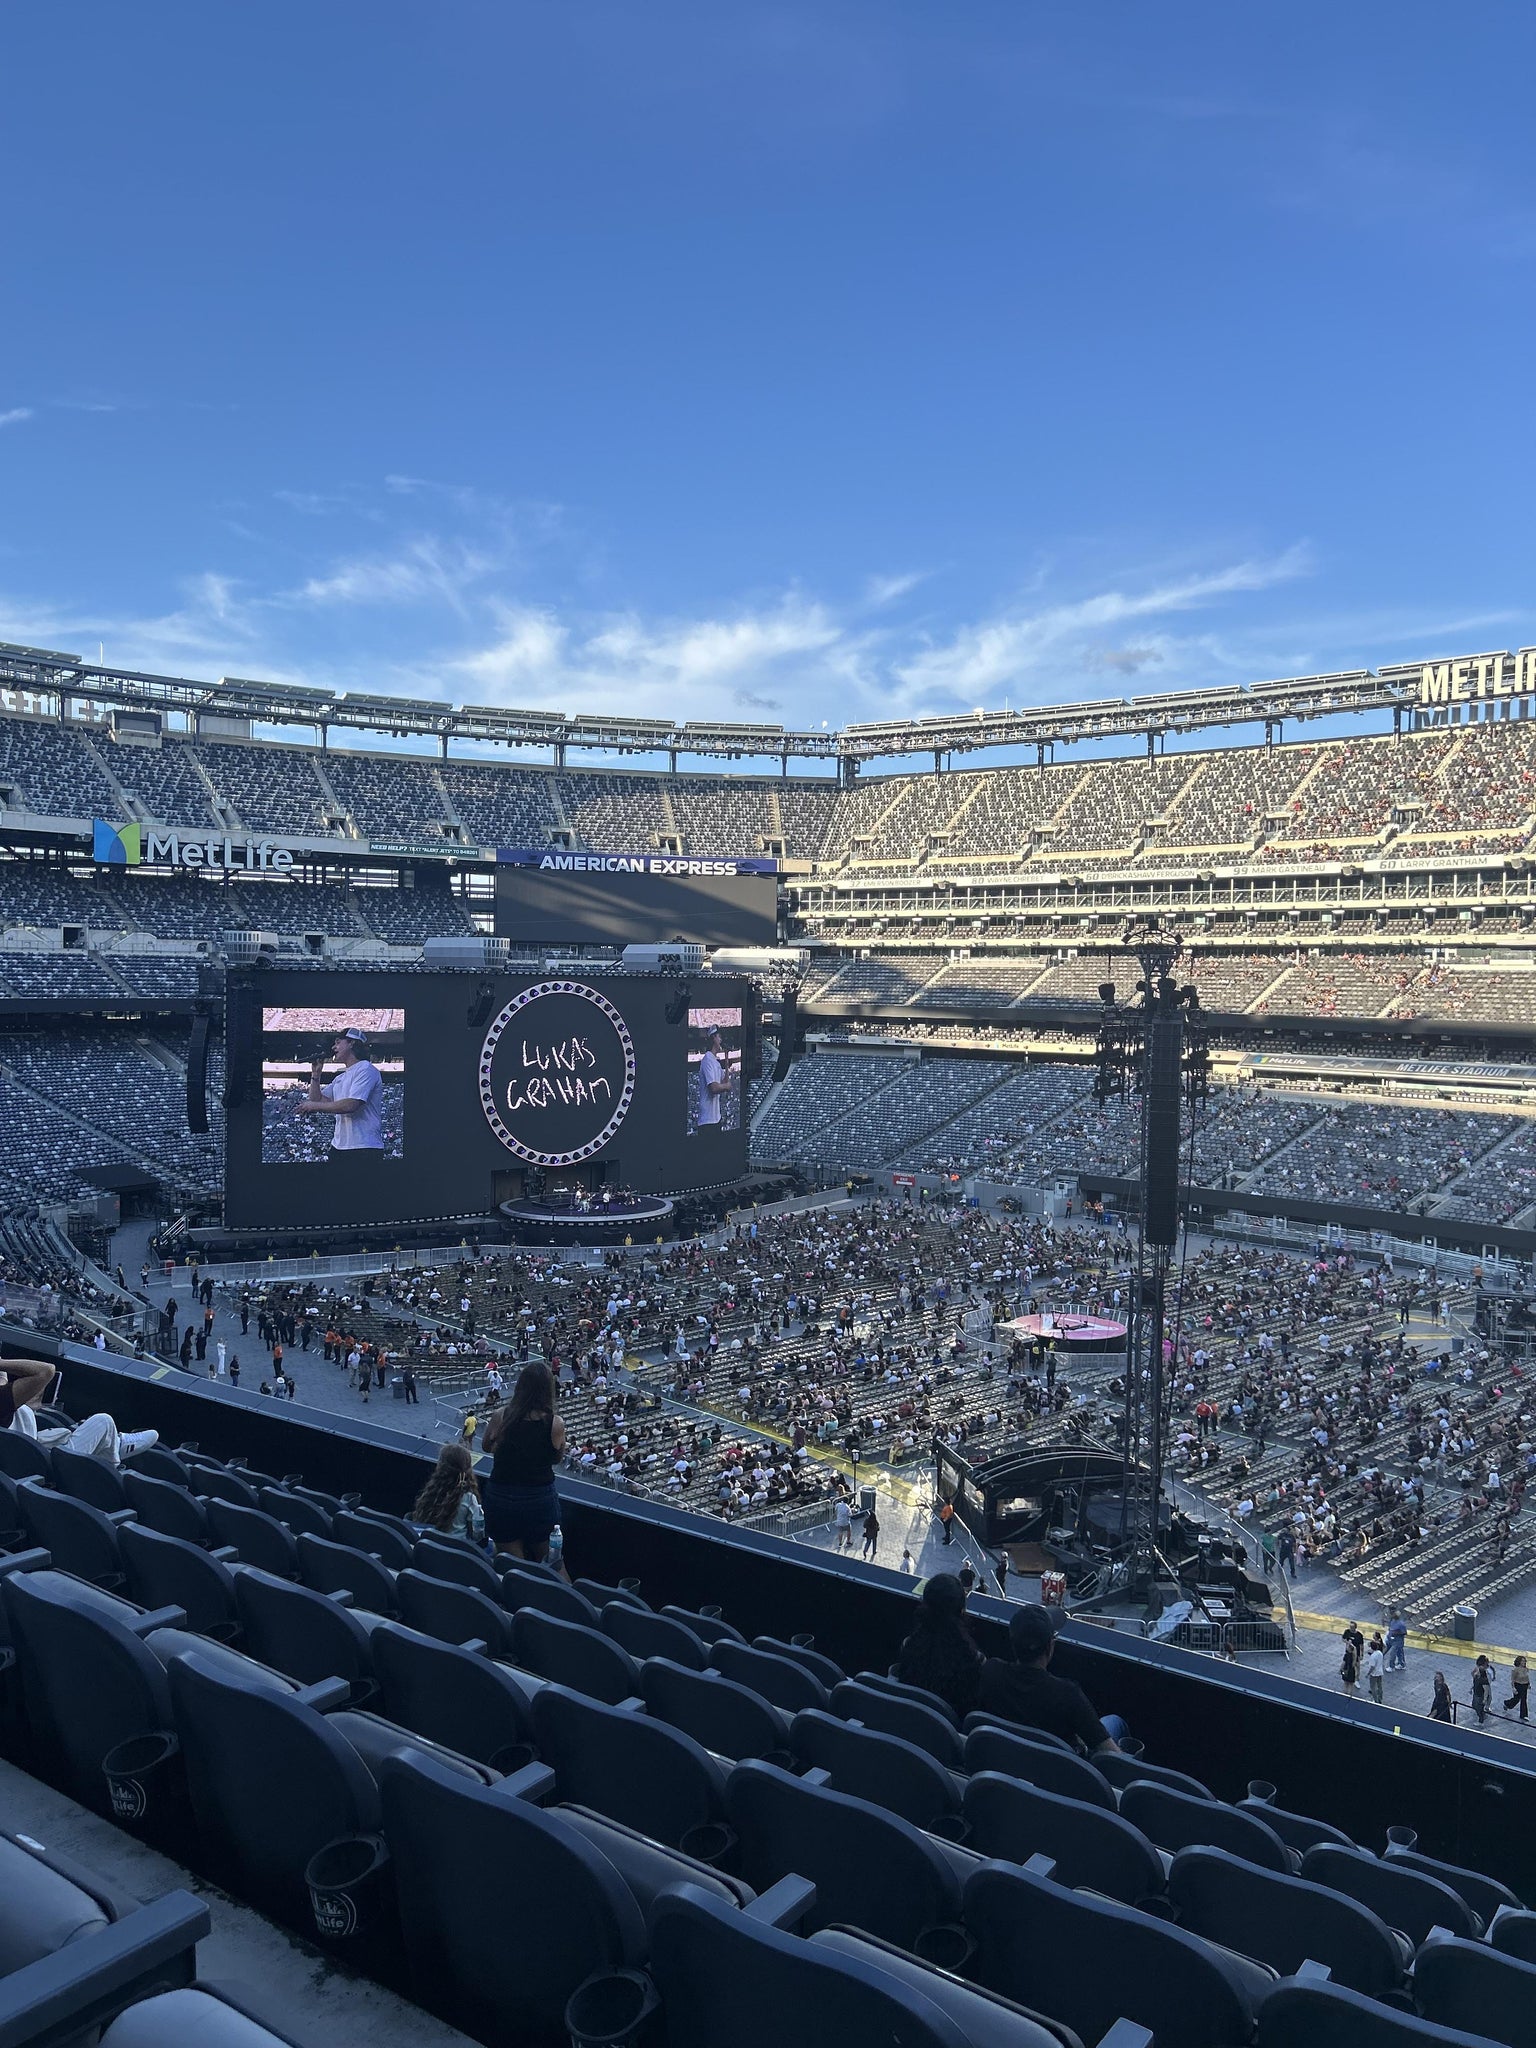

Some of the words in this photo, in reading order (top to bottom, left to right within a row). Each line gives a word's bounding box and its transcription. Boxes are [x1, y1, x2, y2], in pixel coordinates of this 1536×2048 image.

[146, 831, 294, 872] MetLife
[539, 855, 645, 872] AMERICAN
[649, 860, 738, 876] EXPRESS
[1233, 867, 1248, 875] 99
[1278, 865, 1325, 873] GASTINEAU
[1379, 860, 1396, 870] 60
[1400, 860, 1430, 868] LARRY
[1433, 857, 1488, 867] GRANTHAM
[1086, 873, 1099, 881] 60
[1101, 871, 1155, 880] D'BRICKASHAW
[1156, 870, 1195, 878] FERGUSON
[521, 1037, 596, 1071] LUKAS
[1268, 1057, 1307, 1065] MetLife
[1396, 1063, 1448, 1073] METLIFE
[1451, 1065, 1510, 1077] STADIUM
[506, 1077, 611, 1109] GRAHAM
